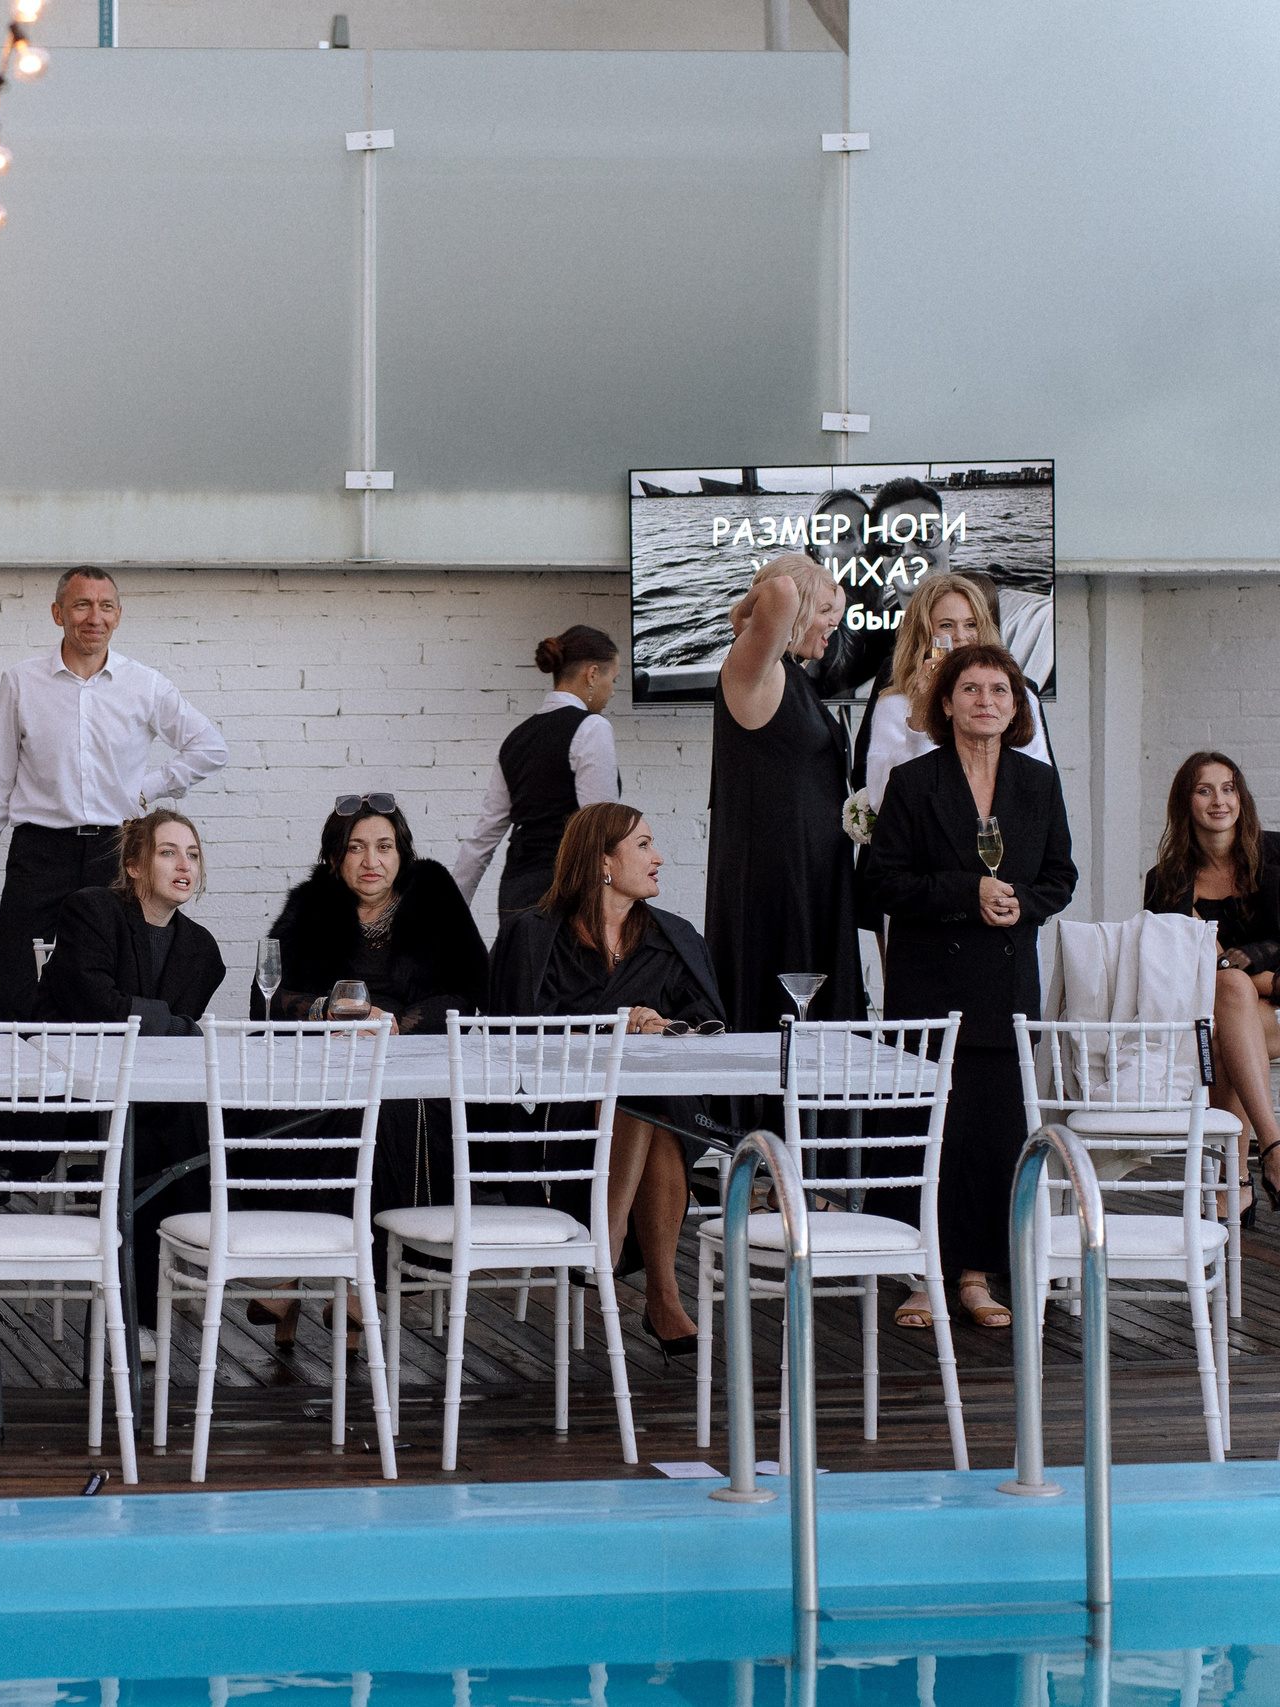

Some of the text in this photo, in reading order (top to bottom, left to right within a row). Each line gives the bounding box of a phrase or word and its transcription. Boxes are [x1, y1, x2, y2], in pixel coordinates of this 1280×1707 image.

[712, 511, 966, 547] РАЗМЕР НОГИ
[750, 556, 929, 587] ИХА?
